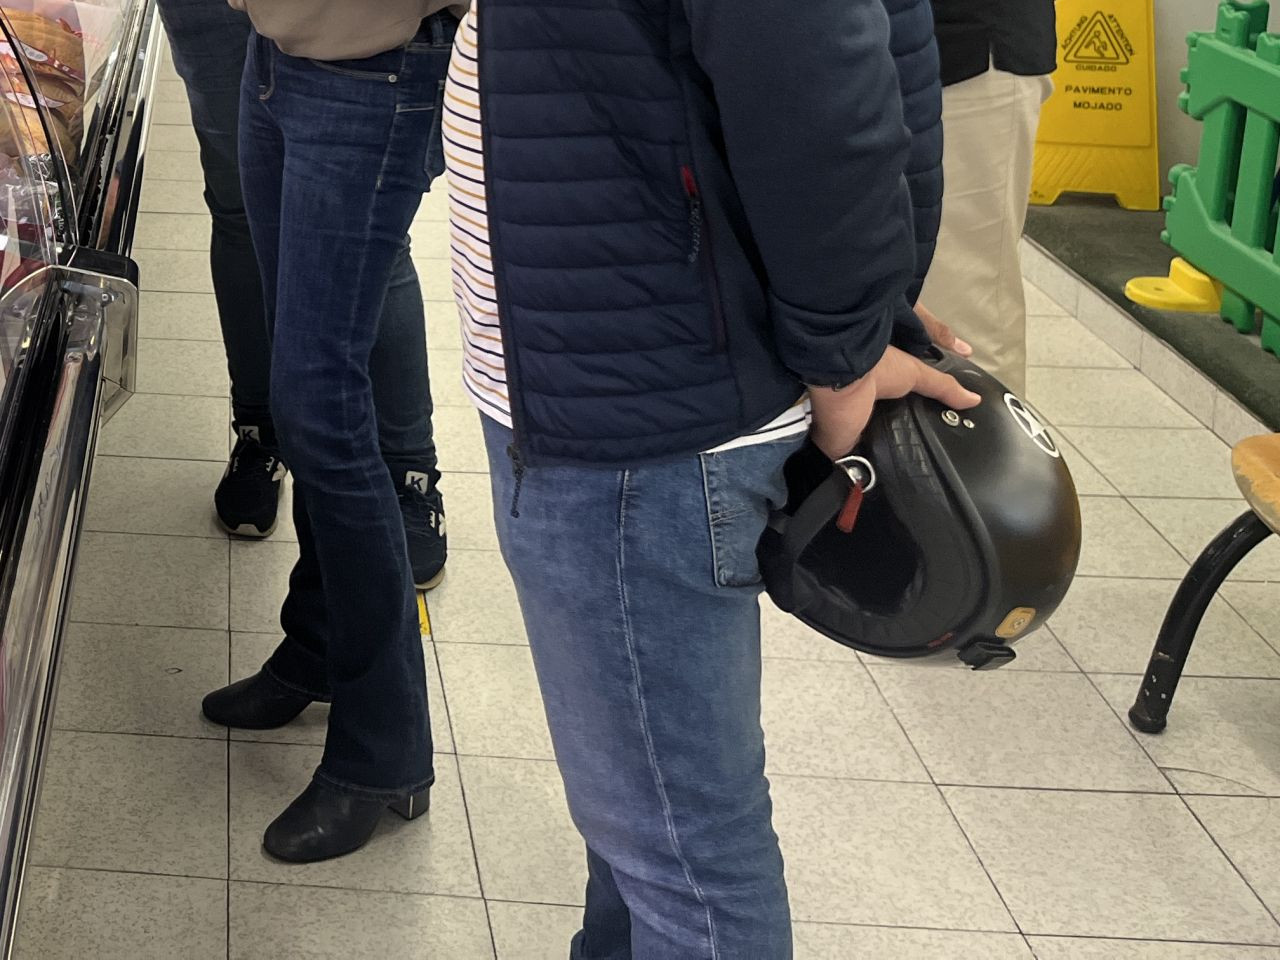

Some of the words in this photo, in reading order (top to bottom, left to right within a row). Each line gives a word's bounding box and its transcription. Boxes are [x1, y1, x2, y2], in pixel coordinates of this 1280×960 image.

[1075, 63, 1117, 72] CUIDADO
[1064, 85, 1132, 96] PAVIMENTO
[1073, 101, 1122, 111] MOJADO
